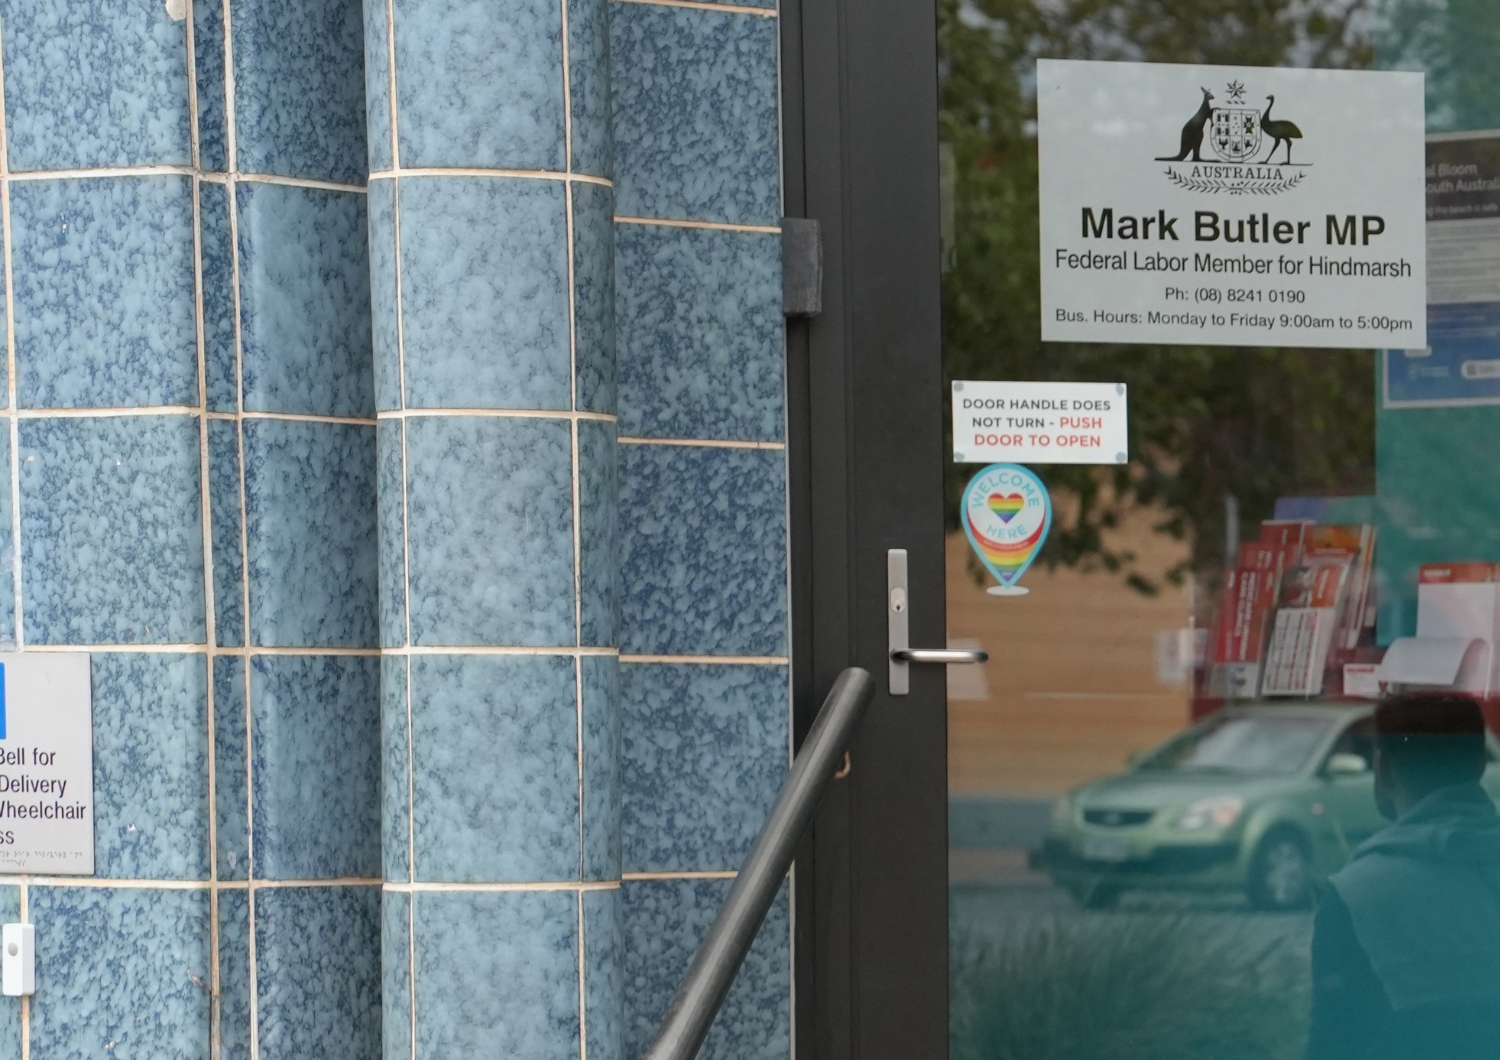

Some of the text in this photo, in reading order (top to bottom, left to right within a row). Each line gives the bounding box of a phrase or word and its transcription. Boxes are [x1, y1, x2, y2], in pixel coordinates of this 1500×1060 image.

[1191, 166, 1284, 181] AUSTRALIA
[1427, 180, 1454, 194] outh
[1082, 207, 1386, 246] Mark Butler MP
[1055, 249, 1127, 270] Federal
[1134, 251, 1189, 272] Labor
[1194, 253, 1271, 275] Member
[1278, 254, 1304, 276] for
[1309, 256, 1411, 278] Hindmarsh
[1165, 288, 1306, 304] Ph: (08) 8241 0190
[1055, 309, 1089, 324] Bus.
[1093, 310, 1143, 324] Hours:
[1147, 311, 1207, 329] Monday
[1211, 313, 1226, 326] to
[1230, 313, 1276, 331] Friday
[1280, 314, 1335, 329] 9:00am
[1339, 316, 1354, 330] to
[1357, 316, 1413, 333] 5:00pm
[963, 398, 1111, 411] DOOR HANDLE DOES
[972, 417, 1002, 428] NOT
[1006, 417, 1045, 429] TURN
[1059, 417, 1103, 429] PUSH
[974, 434, 1101, 447] DOOR TO OPEN
[972, 472, 1040, 509] WELCOME
[986, 523, 1028, 540] HERE
[0, 747, 56, 766] Bell for
[0, 774, 67, 798] Delivery
